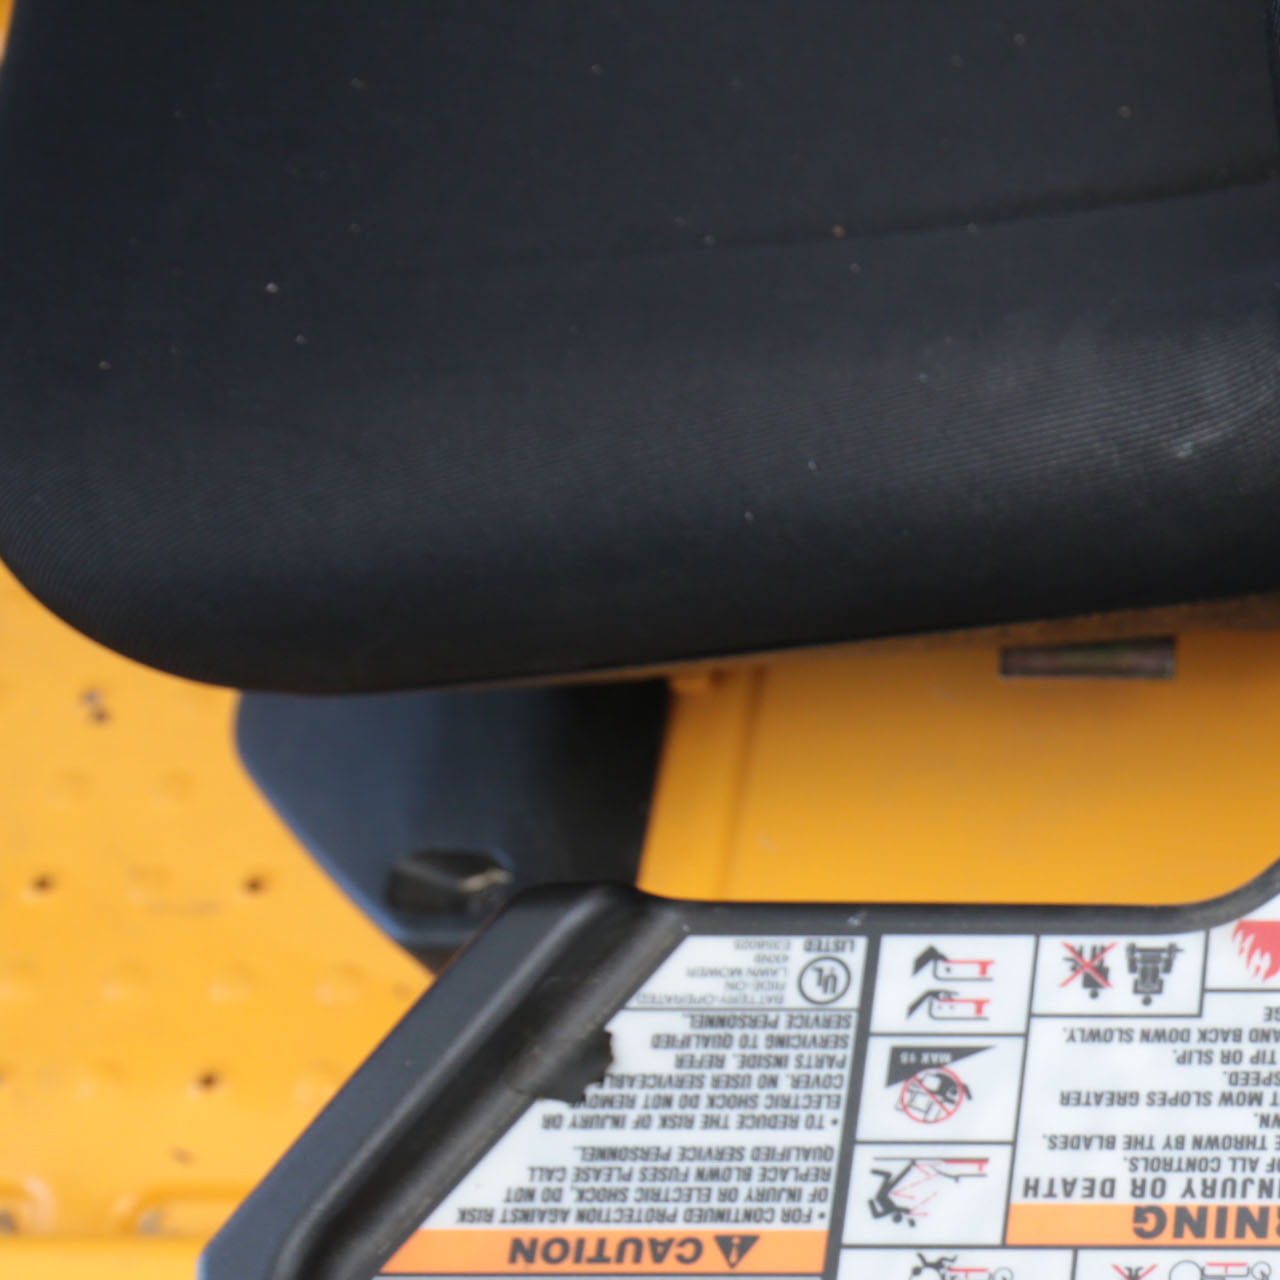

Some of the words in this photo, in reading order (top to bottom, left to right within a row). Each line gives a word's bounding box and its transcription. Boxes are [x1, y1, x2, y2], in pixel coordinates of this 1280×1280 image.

[803, 935, 856, 954] LISTED
[1042, 1134, 1118, 1151] BLADES.
[1122, 1134, 1156, 1152] THE
[1161, 1134, 1187, 1152] BY
[1190, 1134, 1268, 1152] THROWN
[573, 1145, 673, 1163] PERSONNEL.
[677, 1145, 747, 1163] SERVICE
[749, 1145, 836, 1163] QUALIFIED
[1123, 1156, 1223, 1174] CONTROLS.
[1227, 1156, 1261, 1174] ALL
[503, 1187, 538, 1204] NOT
[540, 1186, 564, 1204] DO
[570, 1186, 631, 1204] SHOCK,
[633, 1186, 713, 1204] ELECTRIC
[716, 1186, 740, 1204] OR
[743, 1186, 804, 1204] INJURY
[807, 1186, 830, 1204] OF
[1021, 1177, 1117, 1199] DEATH
[1129, 1176, 1168, 1200] OR
[457, 1207, 496, 1224] RISK
[499, 1207, 572, 1225] AGAINST
[574, 1207, 679, 1224] PROTECTION
[682, 1207, 776, 1224] CONTINUED
[779, 1207, 814, 1224] FOR
[507, 1236, 704, 1265] CAUTION
